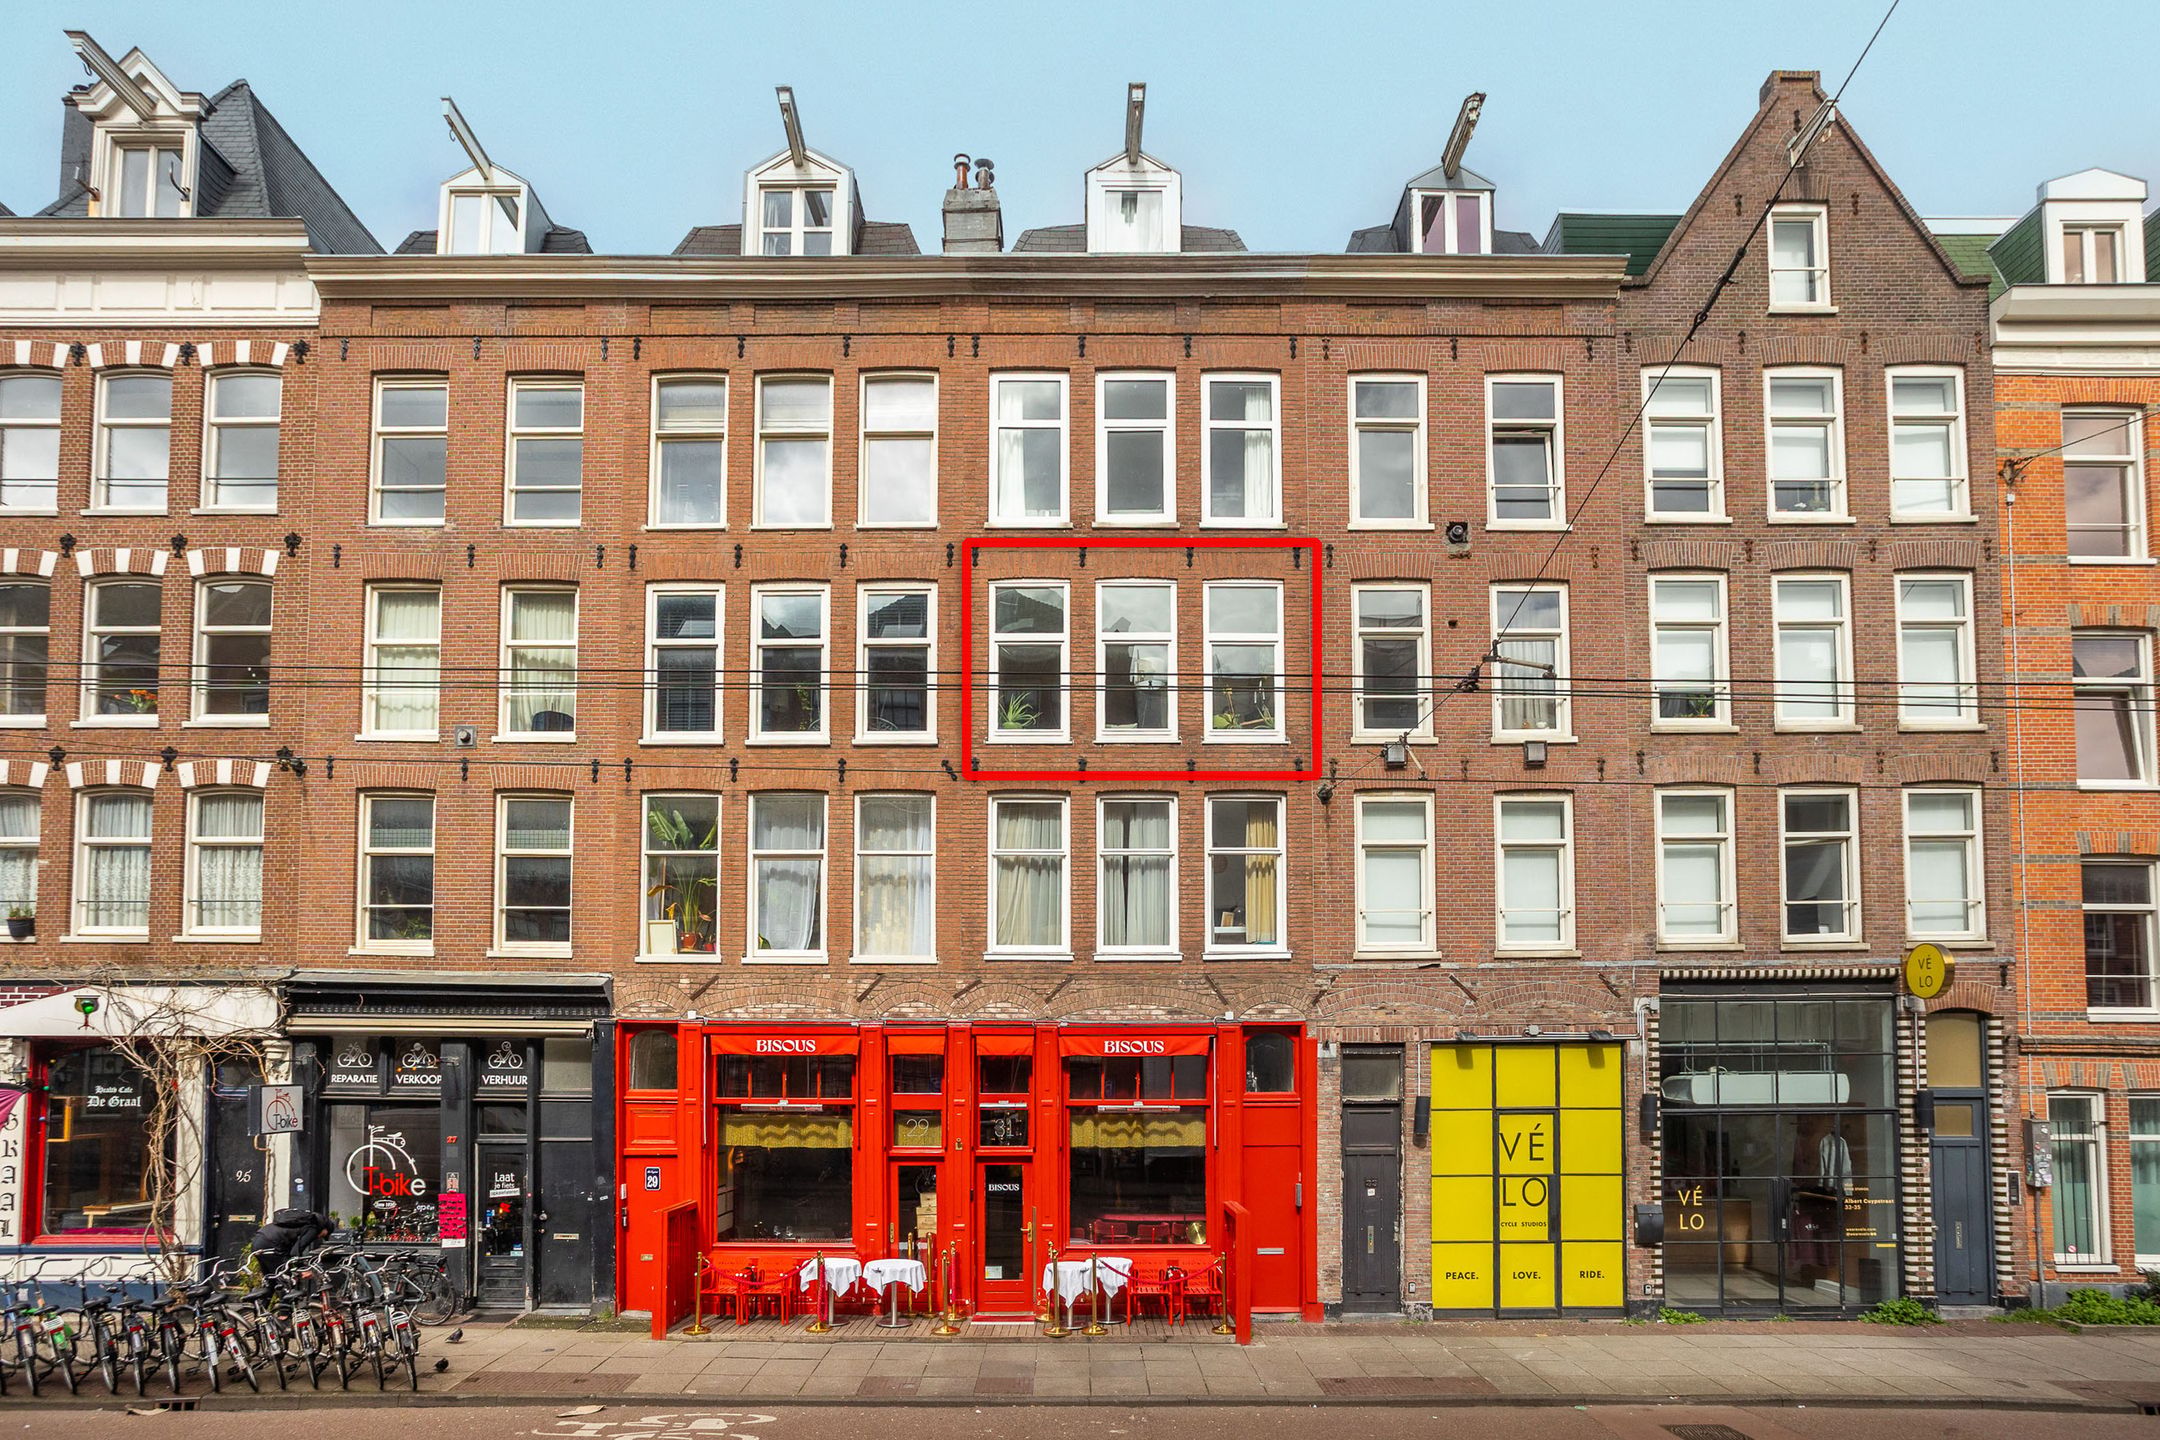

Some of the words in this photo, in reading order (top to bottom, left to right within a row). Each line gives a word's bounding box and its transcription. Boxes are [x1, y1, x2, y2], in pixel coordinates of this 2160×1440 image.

[1918, 954, 1932, 970] VÉ
[1919, 975, 1933, 987] LO
[756, 1039, 816, 1053] BISOUS
[1104, 1040, 1165, 1053] BISOUS
[331, 1074, 378, 1083] REPARATIE
[396, 1075, 441, 1084] VERKOOP
[482, 1075, 528, 1084] VERHUUR
[87, 1095, 106, 1107] De
[108, 1095, 142, 1107] Graal
[907, 1118, 929, 1137] 29
[995, 1119, 1014, 1137] 31
[446, 1135, 458, 1144] 27
[1499, 1123, 1544, 1161] VÉ
[362, 1166, 426, 1196] T-bike
[494, 1172, 515, 1182] Laat
[647, 1175, 658, 1188] 29
[494, 1182, 501, 1190] je
[988, 1183, 1020, 1191] BISOUS
[1503, 1177, 1546, 1207] LO
[1678, 1184, 1703, 1206] VÉ
[1680, 1213, 1704, 1230] LO
[1445, 1272, 1479, 1280] PEACE.
[1513, 1271, 1541, 1279] LOVE.
[1579, 1270, 1605, 1279] RIDE.
